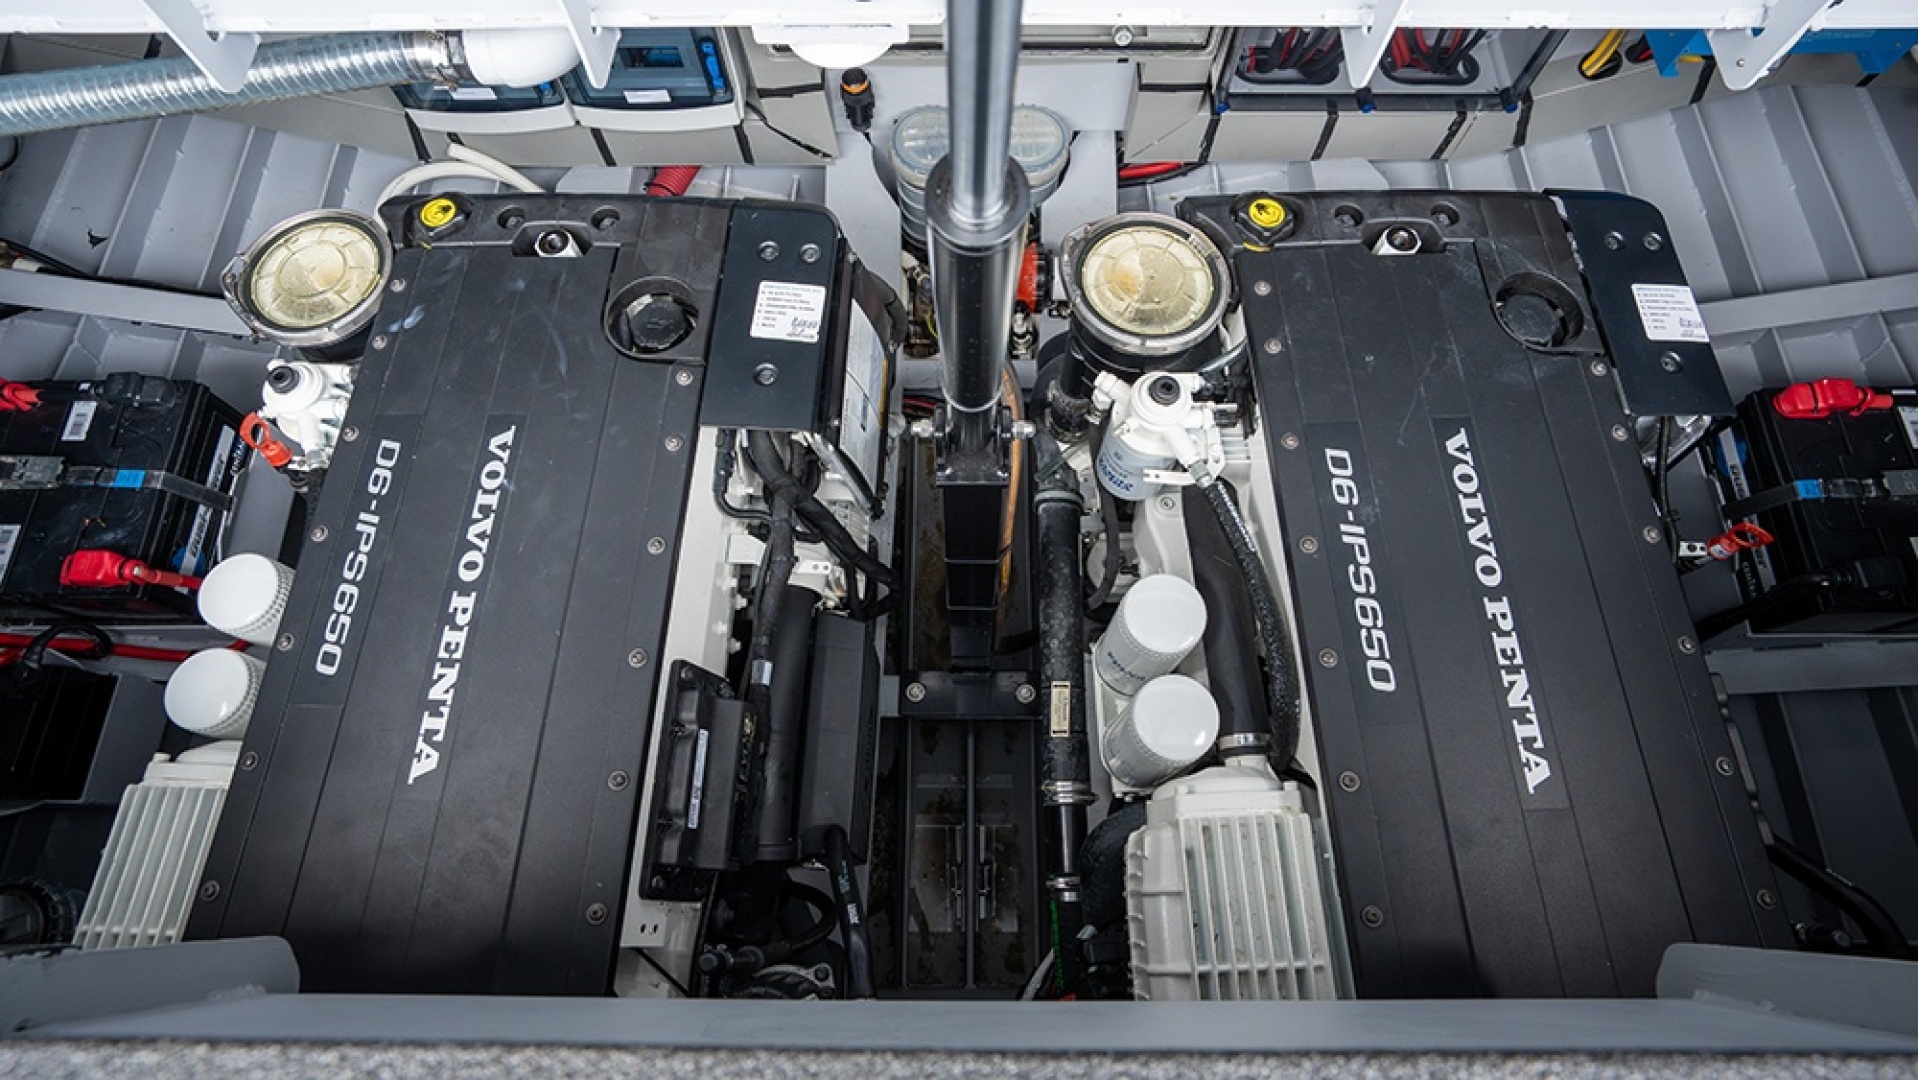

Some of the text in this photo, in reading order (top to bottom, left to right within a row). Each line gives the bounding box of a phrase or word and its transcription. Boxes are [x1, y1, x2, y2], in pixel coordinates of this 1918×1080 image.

[315, 439, 401, 676] D6-IPS650
[407, 426, 516, 785] VOLVO PENTA
[1324, 448, 1397, 692] D6-IPS650
[1445, 428, 1551, 794] VOLVO PENTA
